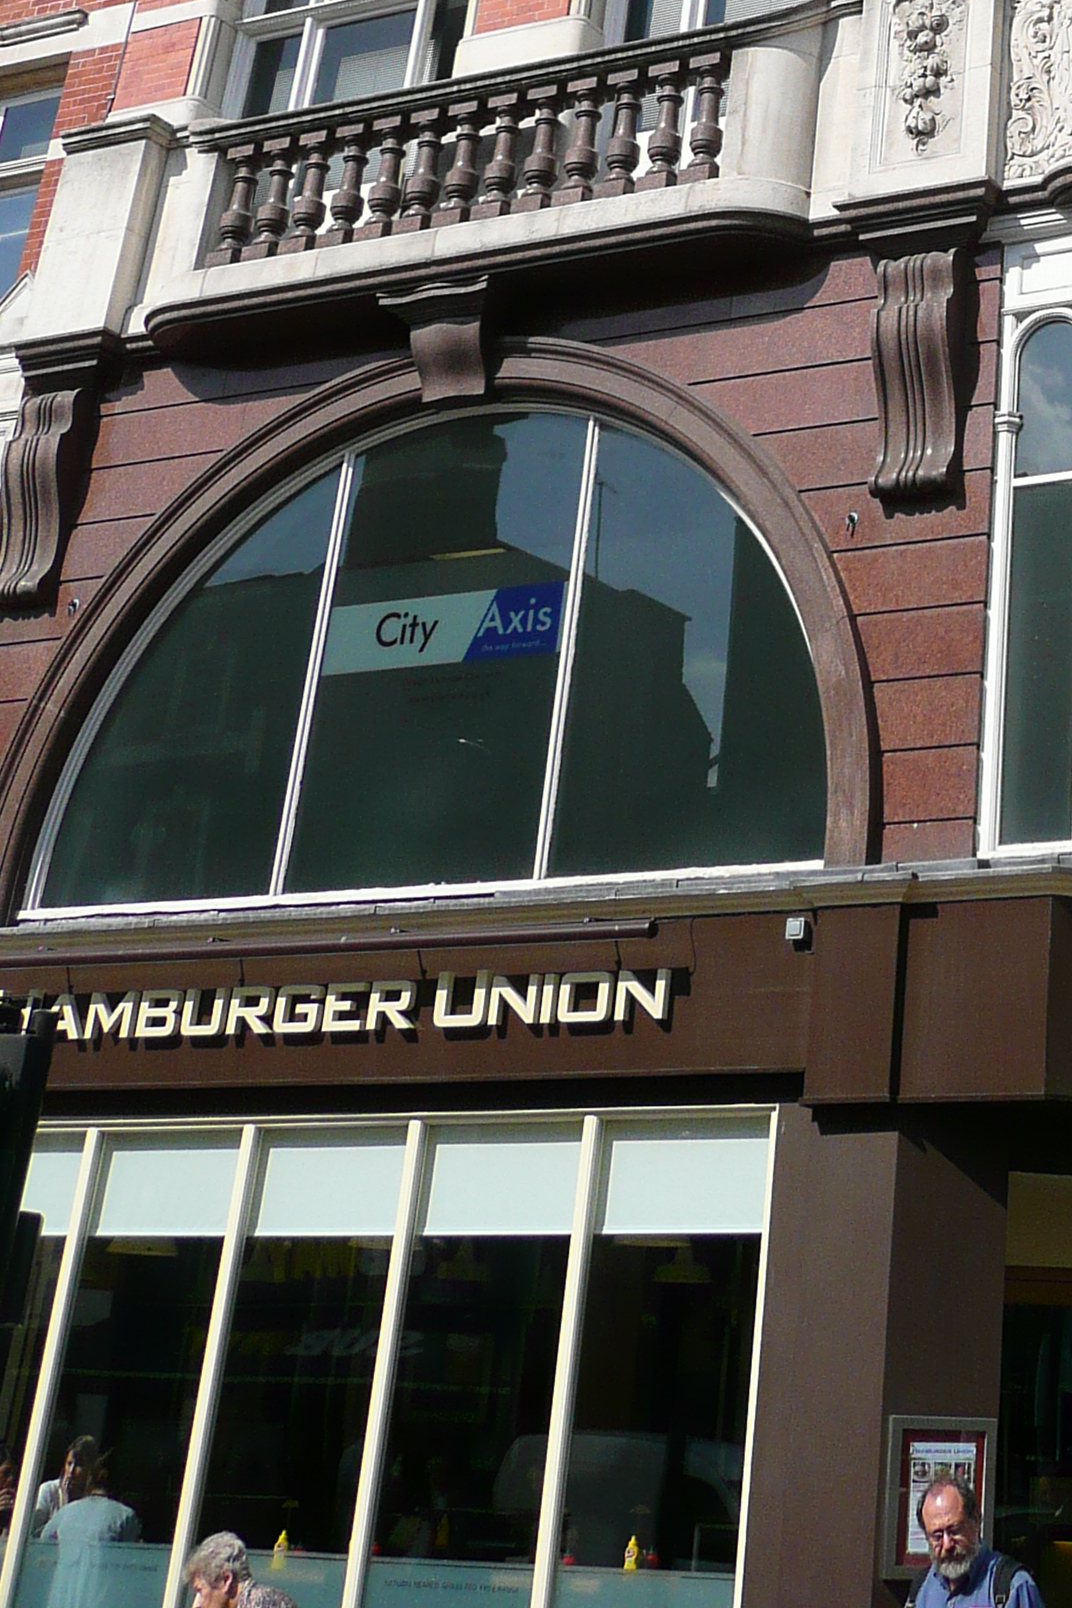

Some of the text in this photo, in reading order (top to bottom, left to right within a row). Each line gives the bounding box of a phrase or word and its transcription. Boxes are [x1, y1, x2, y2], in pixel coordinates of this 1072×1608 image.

[375, 597, 552, 653] City Axis
[433, 969, 672, 1028] UNION
